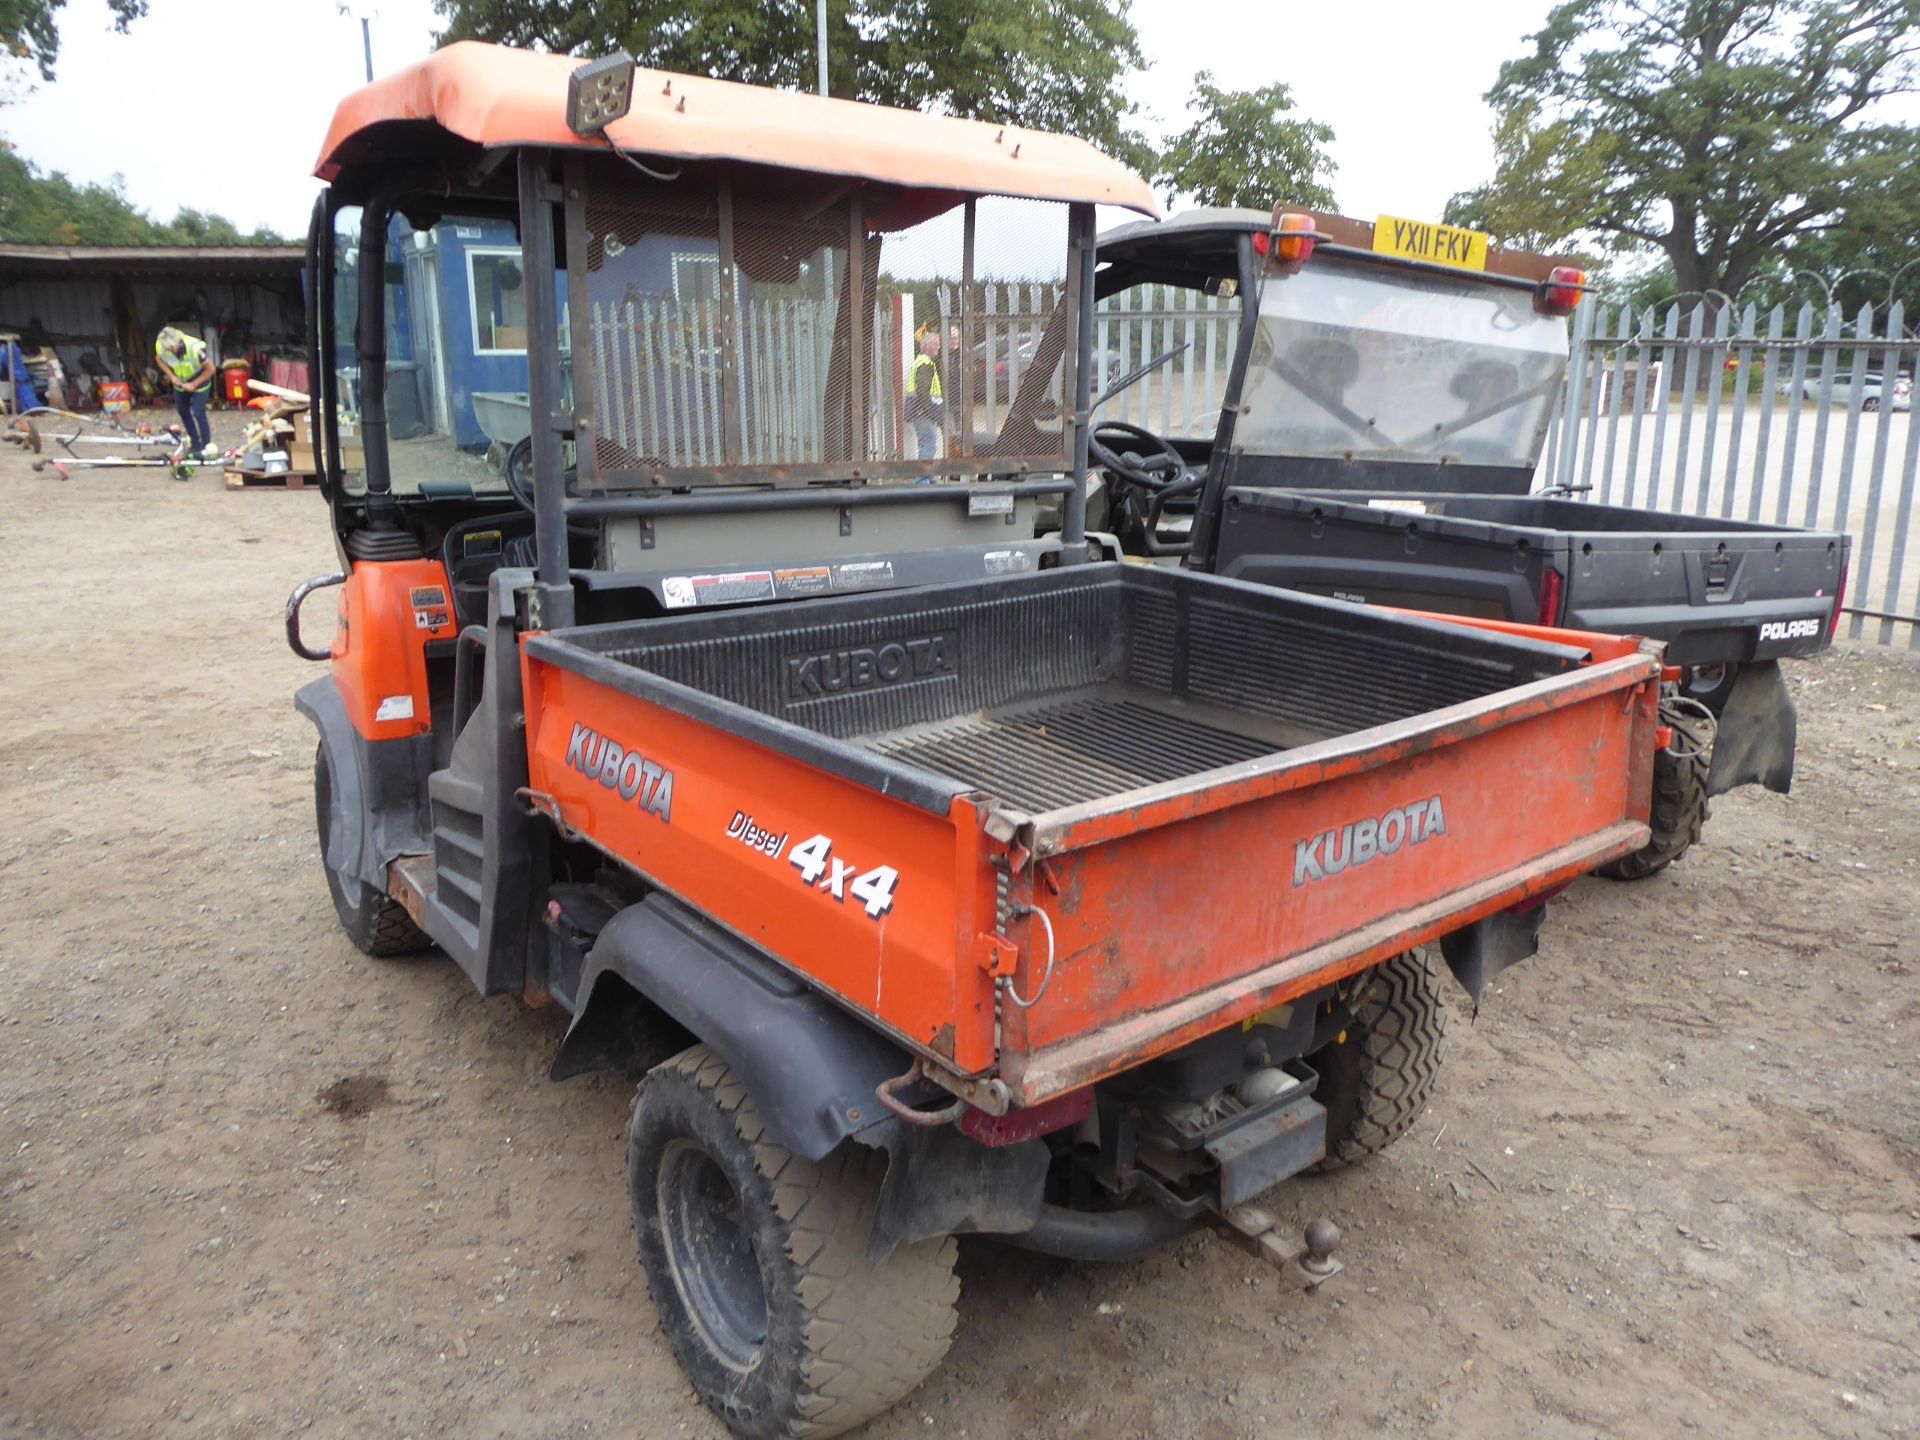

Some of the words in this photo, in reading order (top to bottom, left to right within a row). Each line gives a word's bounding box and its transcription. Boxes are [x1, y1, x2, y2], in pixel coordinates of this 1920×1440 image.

[1394, 219, 1431, 255] YX11
[1434, 229, 1473, 263] FKV
[789, 636, 953, 698] KUBOTA
[1759, 619, 1820, 641] POLARIS
[565, 721, 674, 824] KUBOTA
[726, 809, 789, 860] Diesel
[788, 833, 900, 921] 4x4
[1292, 794, 1446, 888] KUBOTA
